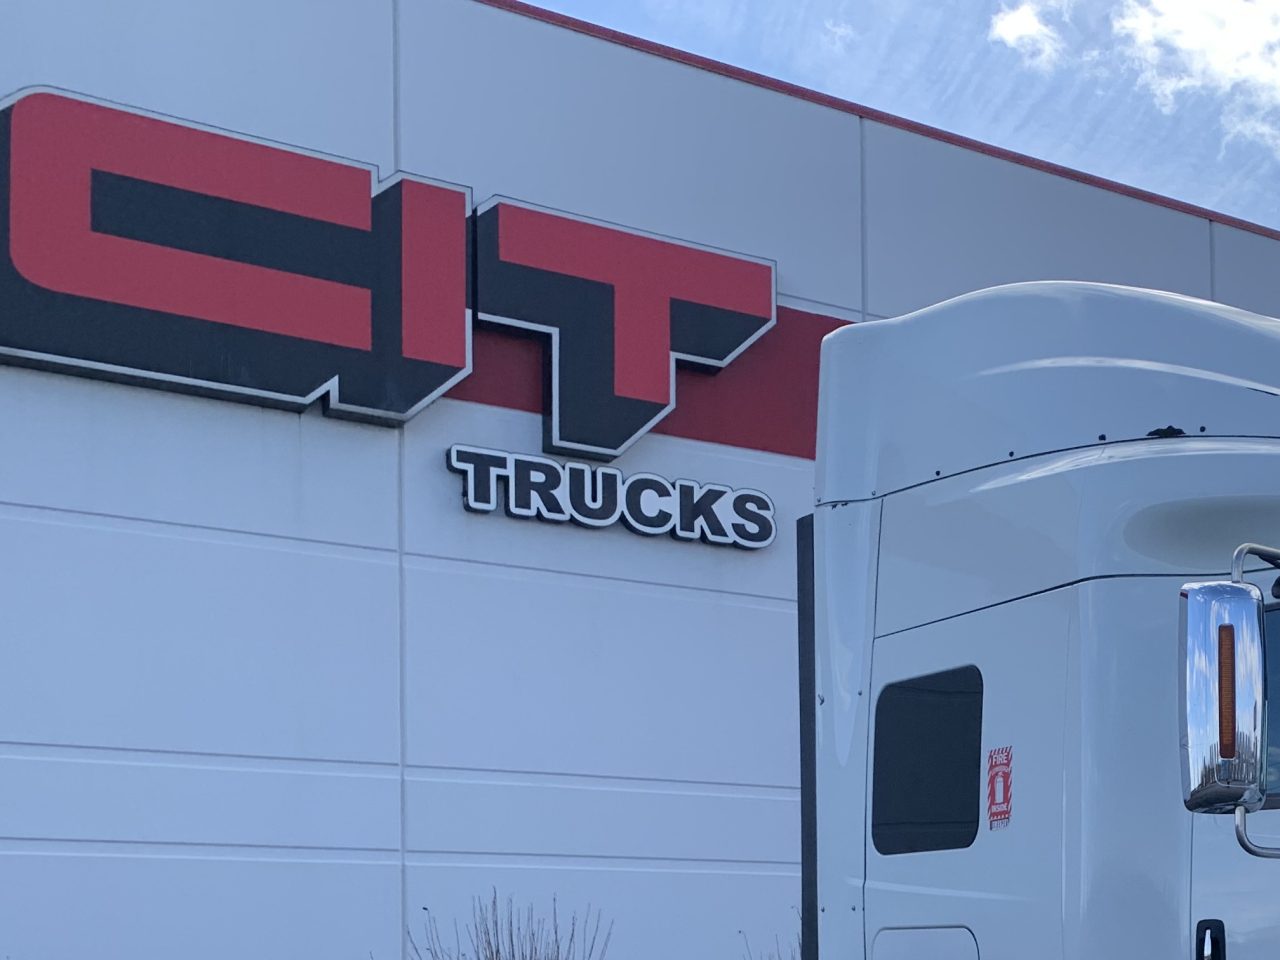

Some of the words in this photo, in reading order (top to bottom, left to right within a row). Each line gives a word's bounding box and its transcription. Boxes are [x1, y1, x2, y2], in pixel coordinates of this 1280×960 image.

[5, 89, 775, 420] CIT
[454, 448, 775, 544] TRUCKS
[992, 753, 1008, 765] FIRE
